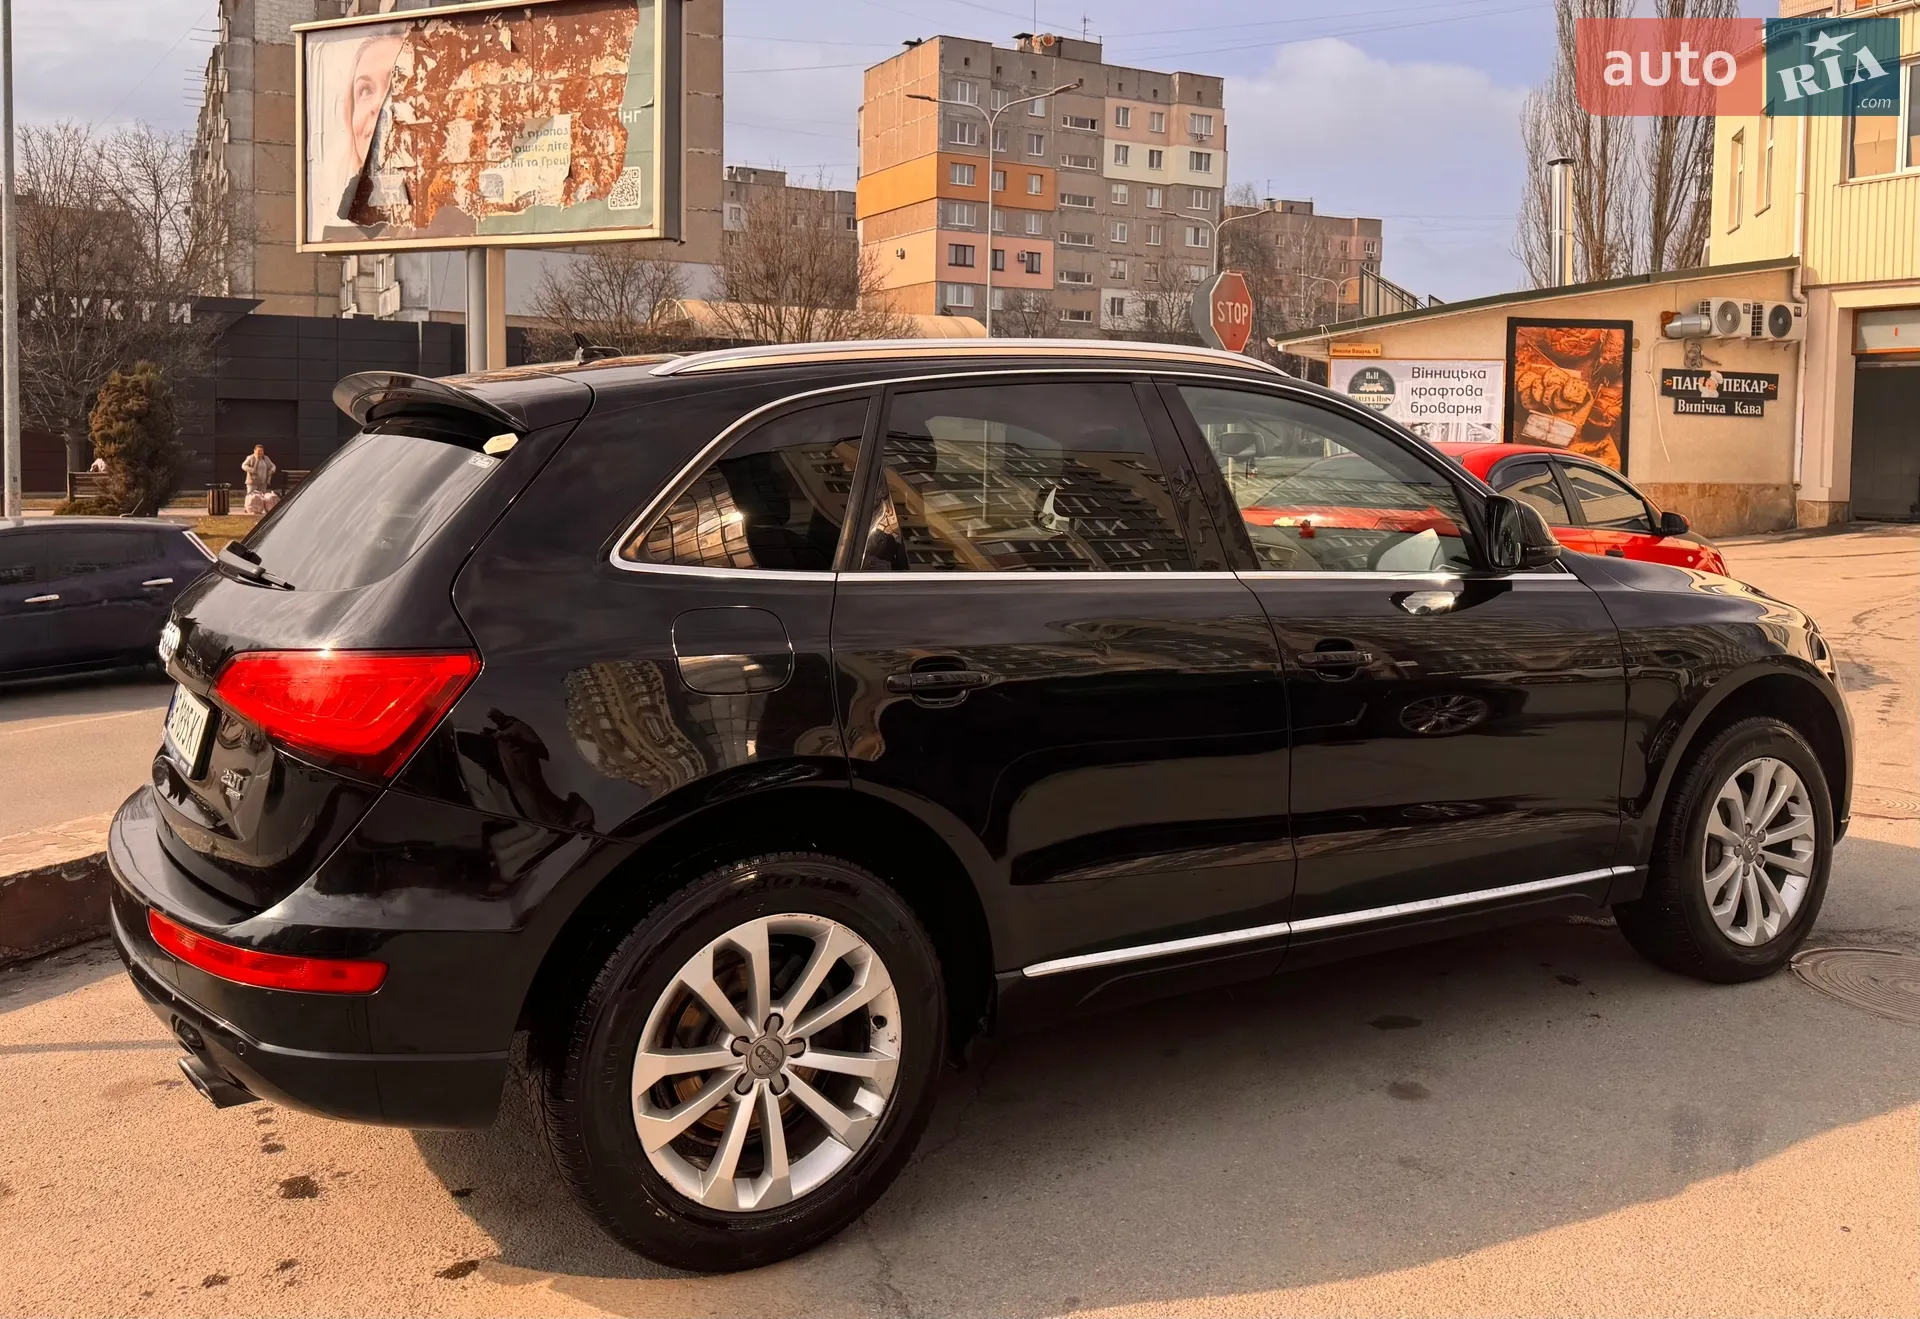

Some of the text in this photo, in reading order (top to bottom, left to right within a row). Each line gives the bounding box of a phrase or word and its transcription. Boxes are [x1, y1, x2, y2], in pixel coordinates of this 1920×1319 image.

[1217, 300, 1249, 326] STOP
[1411, 366, 1487, 382] Вінницька
[1411, 384, 1483, 399] крафтова
[1722, 378, 1768, 393] ПЕКАР
[1410, 401, 1482, 416] броварня
[1677, 399, 1762, 415] Випічка Кава
